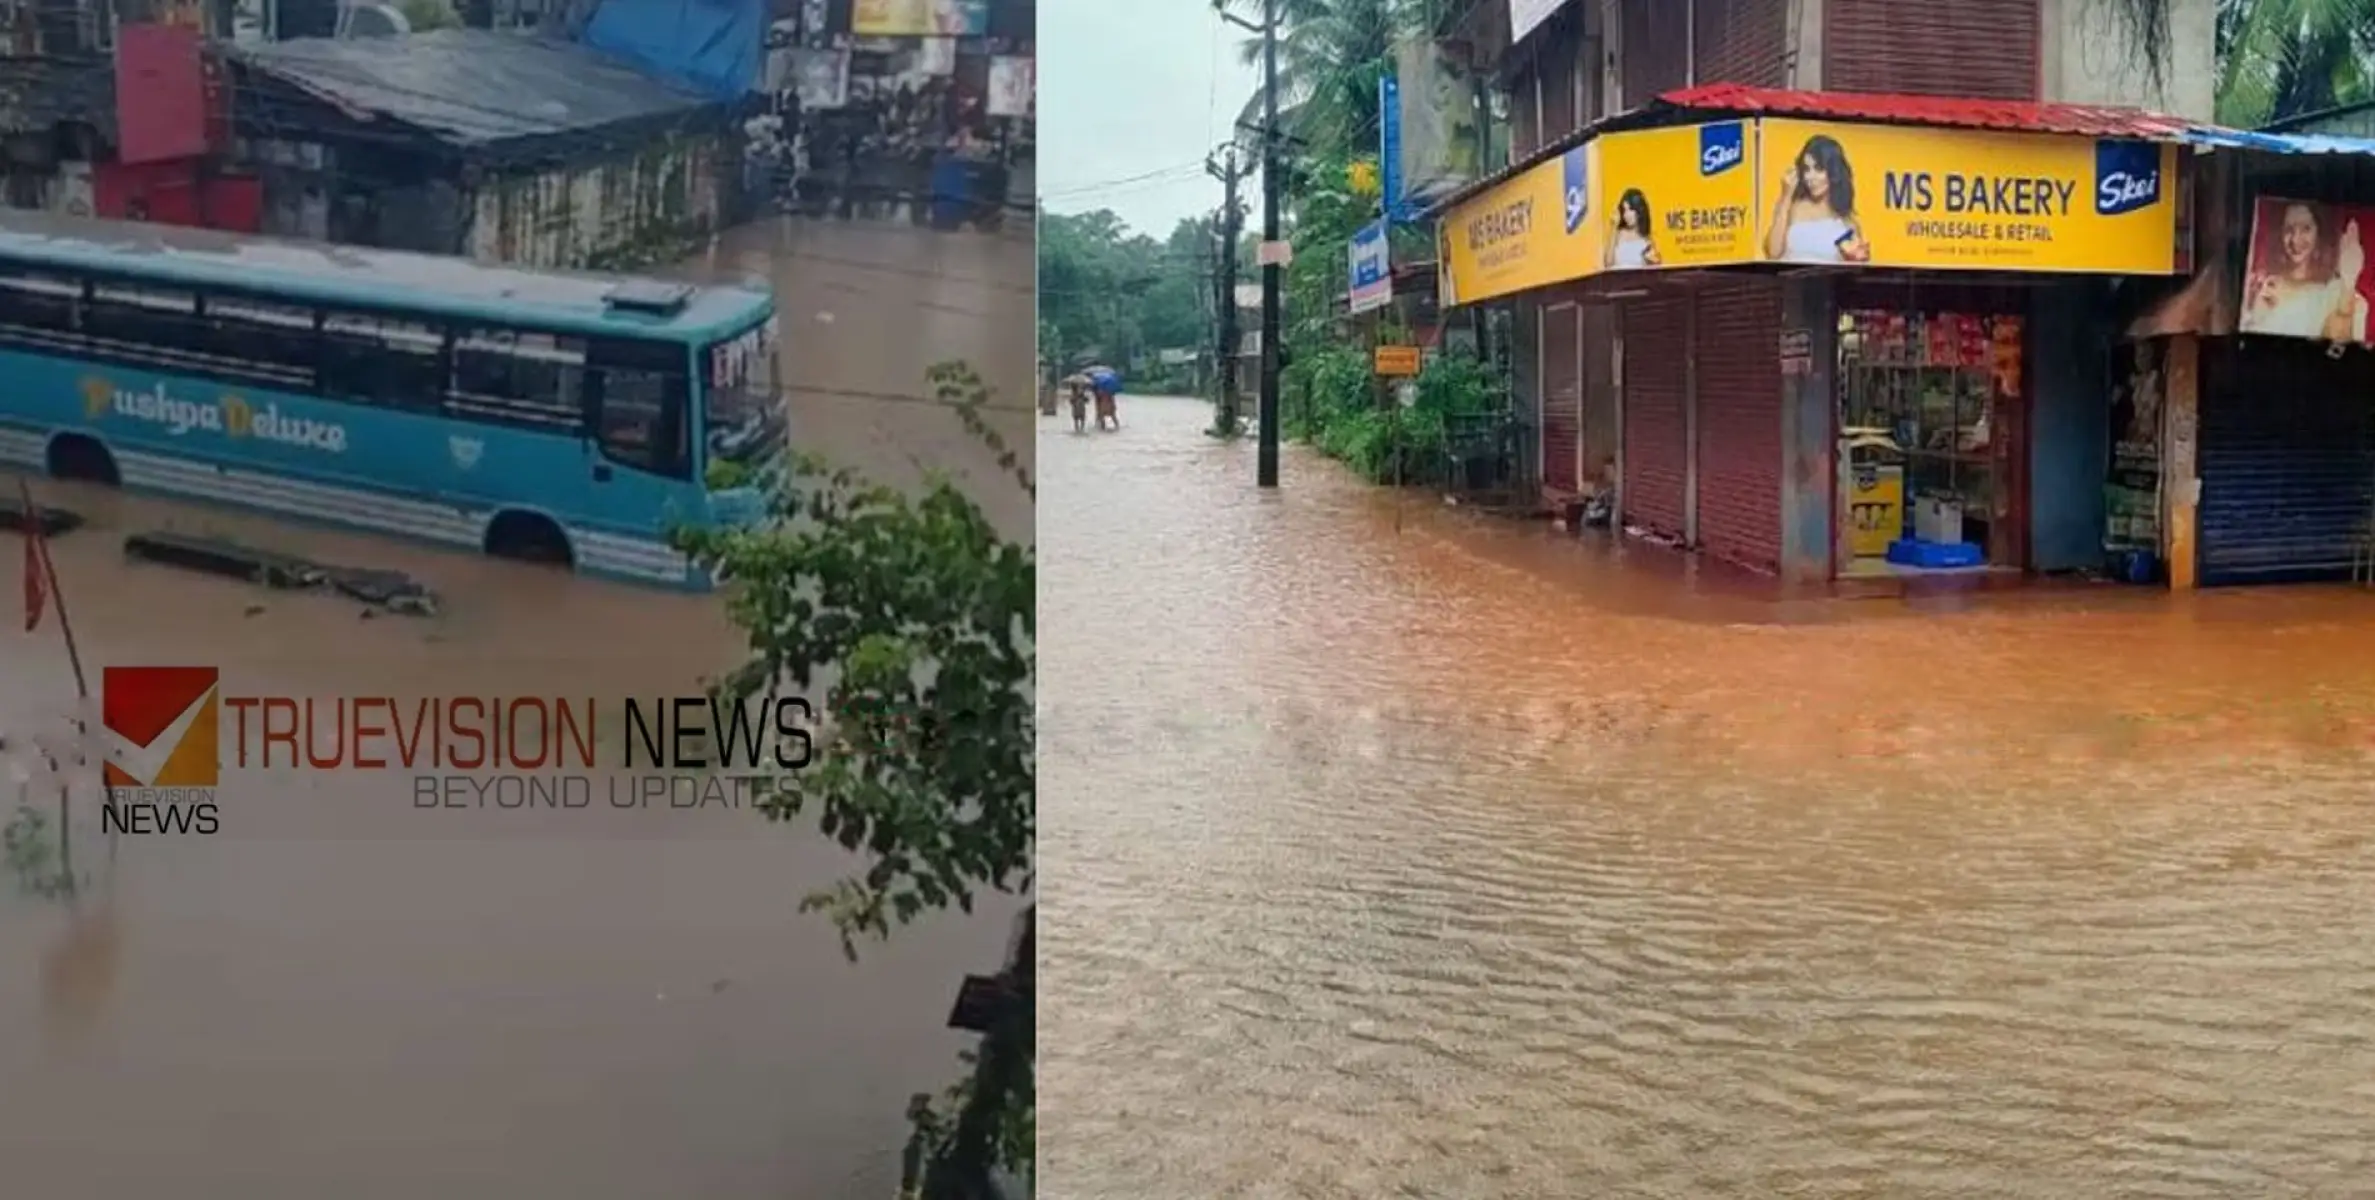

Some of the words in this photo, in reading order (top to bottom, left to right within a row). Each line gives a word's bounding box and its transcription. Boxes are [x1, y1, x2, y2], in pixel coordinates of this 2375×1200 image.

[1884, 171, 1932, 212] MS
[1945, 174, 2077, 216] BAKERY
[1468, 219, 1485, 251] MS
[1486, 195, 1534, 245] BAKERY
[1666, 209, 1686, 230] MS
[1691, 205, 1748, 230] BAKERY
[1907, 220, 1990, 240] WHOLESALE
[1994, 223, 2002, 241] &
[2006, 223, 2054, 242] RETAIL
[80, 374, 221, 436] Pushpa
[219, 393, 348, 451] Deluxe
